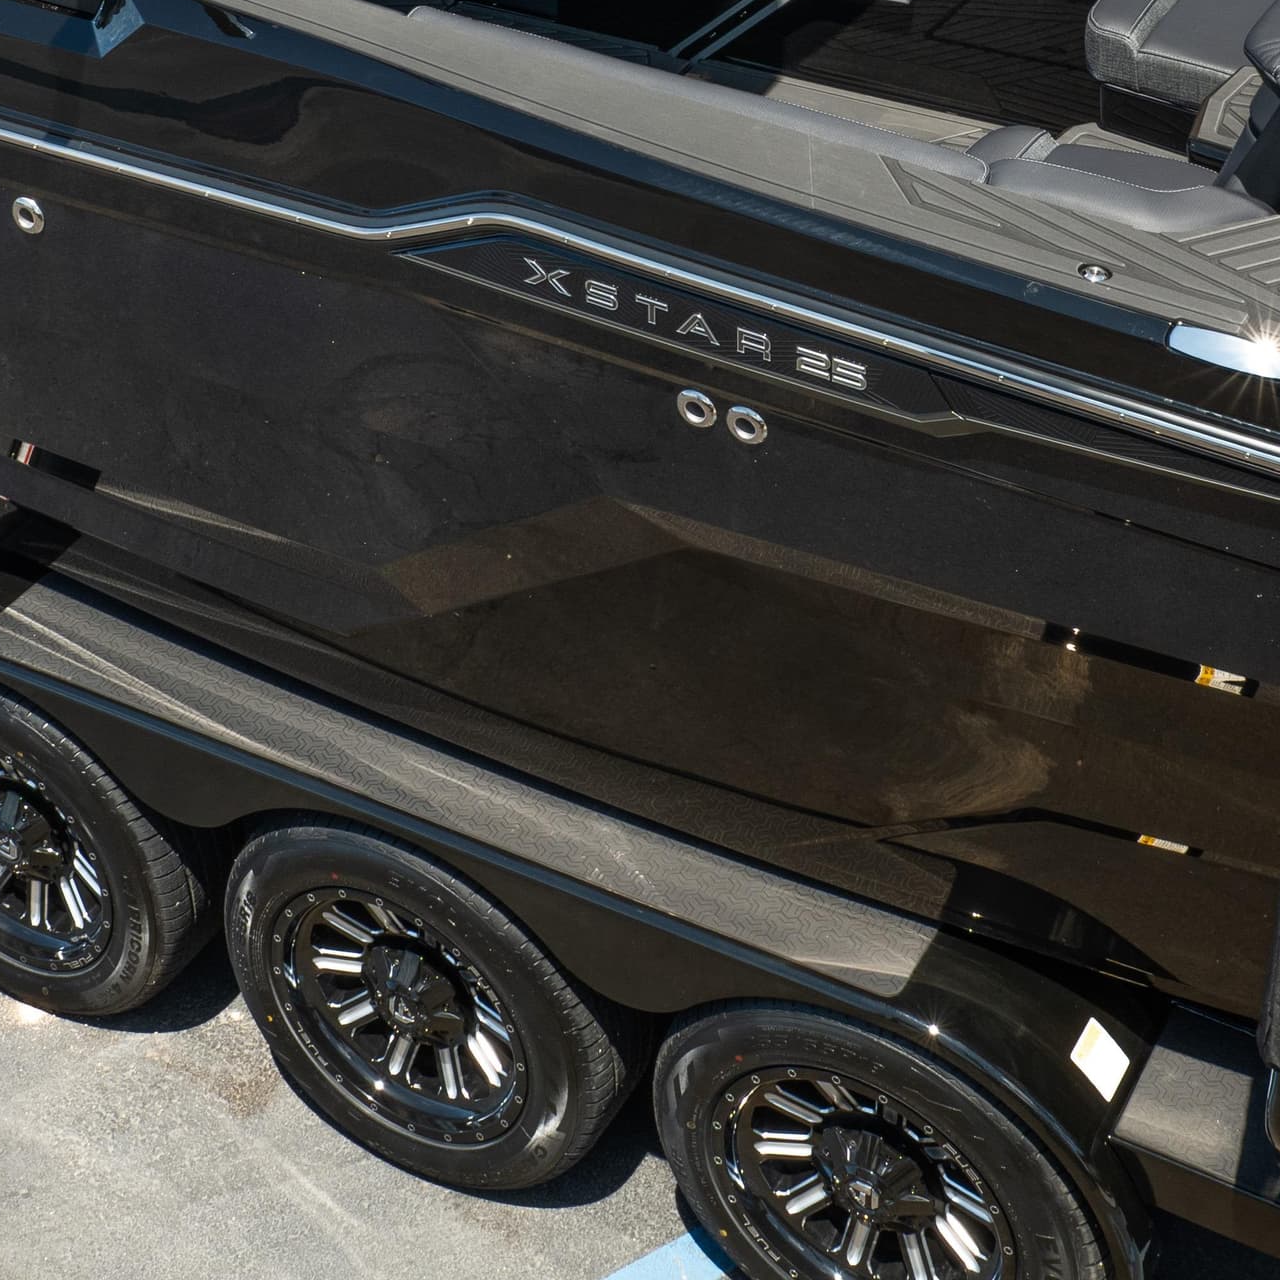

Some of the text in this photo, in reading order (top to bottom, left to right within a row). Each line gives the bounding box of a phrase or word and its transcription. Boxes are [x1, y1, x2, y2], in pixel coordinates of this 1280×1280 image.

[795, 344, 869, 392] 25
[63, 953, 95, 970] FUEL
[295, 1022, 329, 1067] FUEL
[941, 1142, 985, 1194] FUEL
[741, 1213, 782, 1263] FUEL
